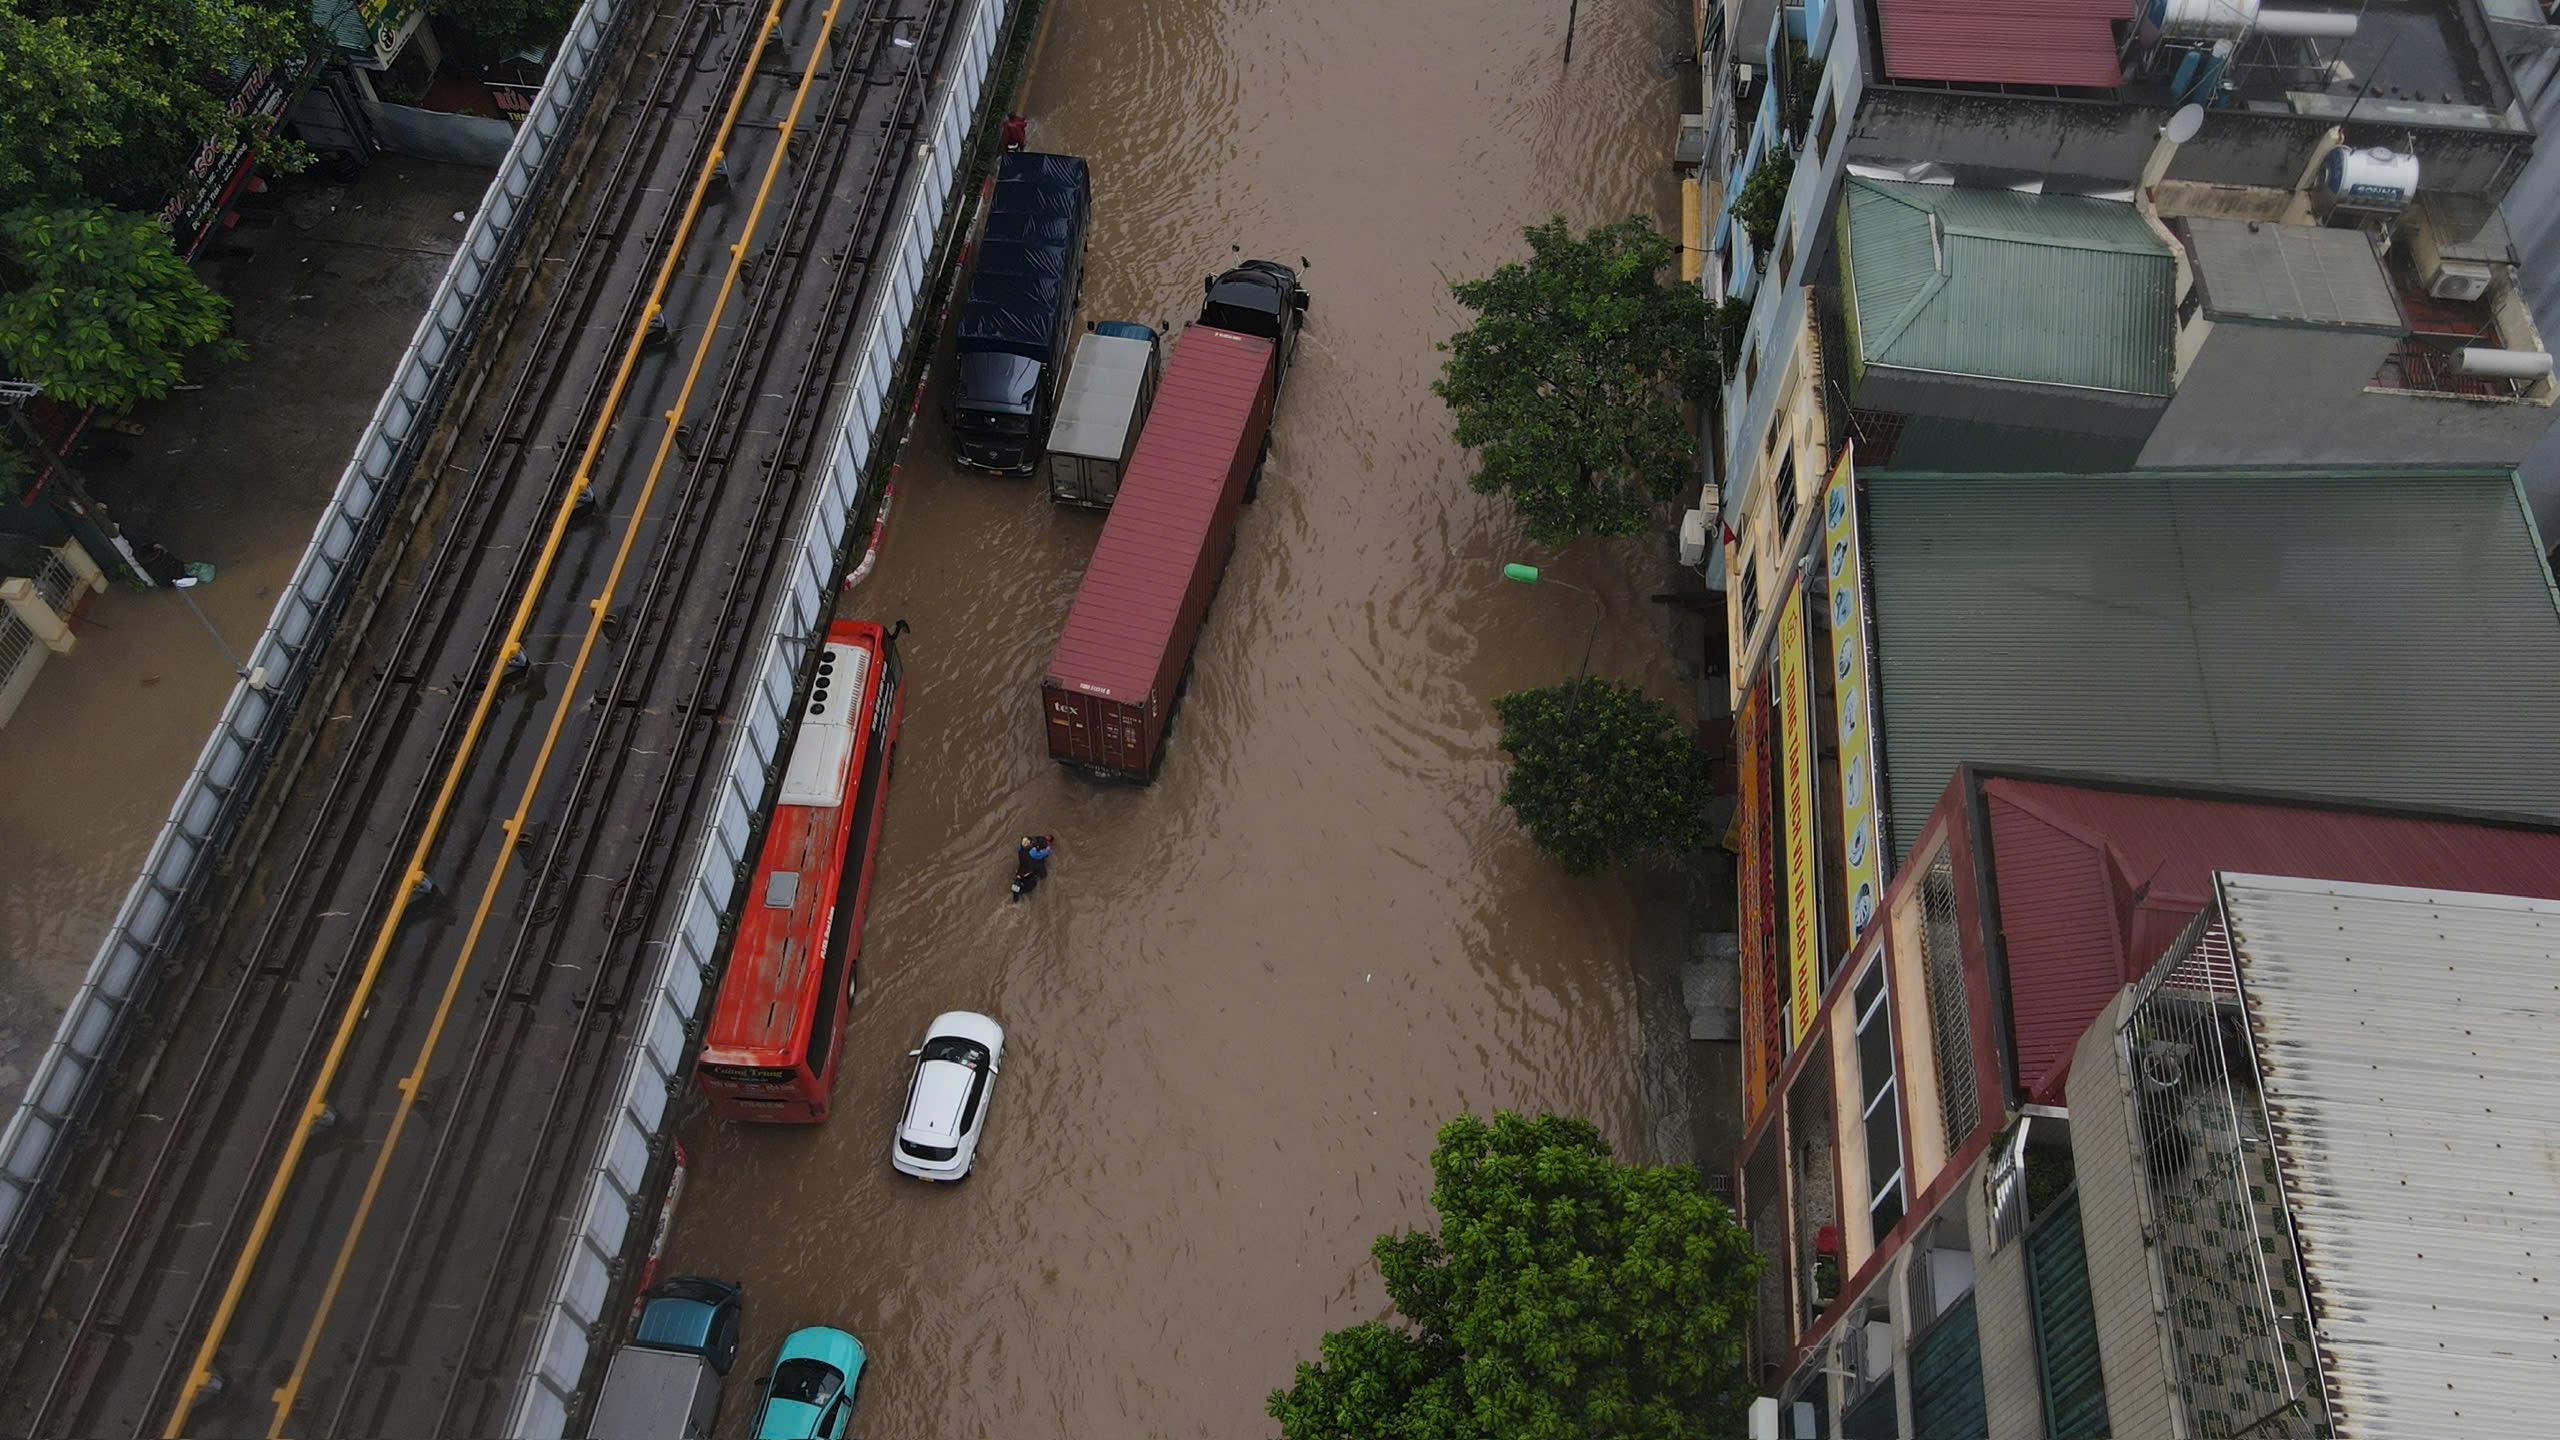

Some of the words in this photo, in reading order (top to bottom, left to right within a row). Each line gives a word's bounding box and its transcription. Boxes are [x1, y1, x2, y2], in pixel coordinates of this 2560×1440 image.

[1054, 701, 1079, 716] tex
[1786, 664, 1797, 739] TRUNG
[1788, 731, 1800, 787] TÂM
[1790, 782, 1802, 841] DỊCH
[1792, 837, 1803, 876] VỤ
[1796, 906, 1809, 961] BẢO
[1798, 960, 1810, 1034] HÀNH
